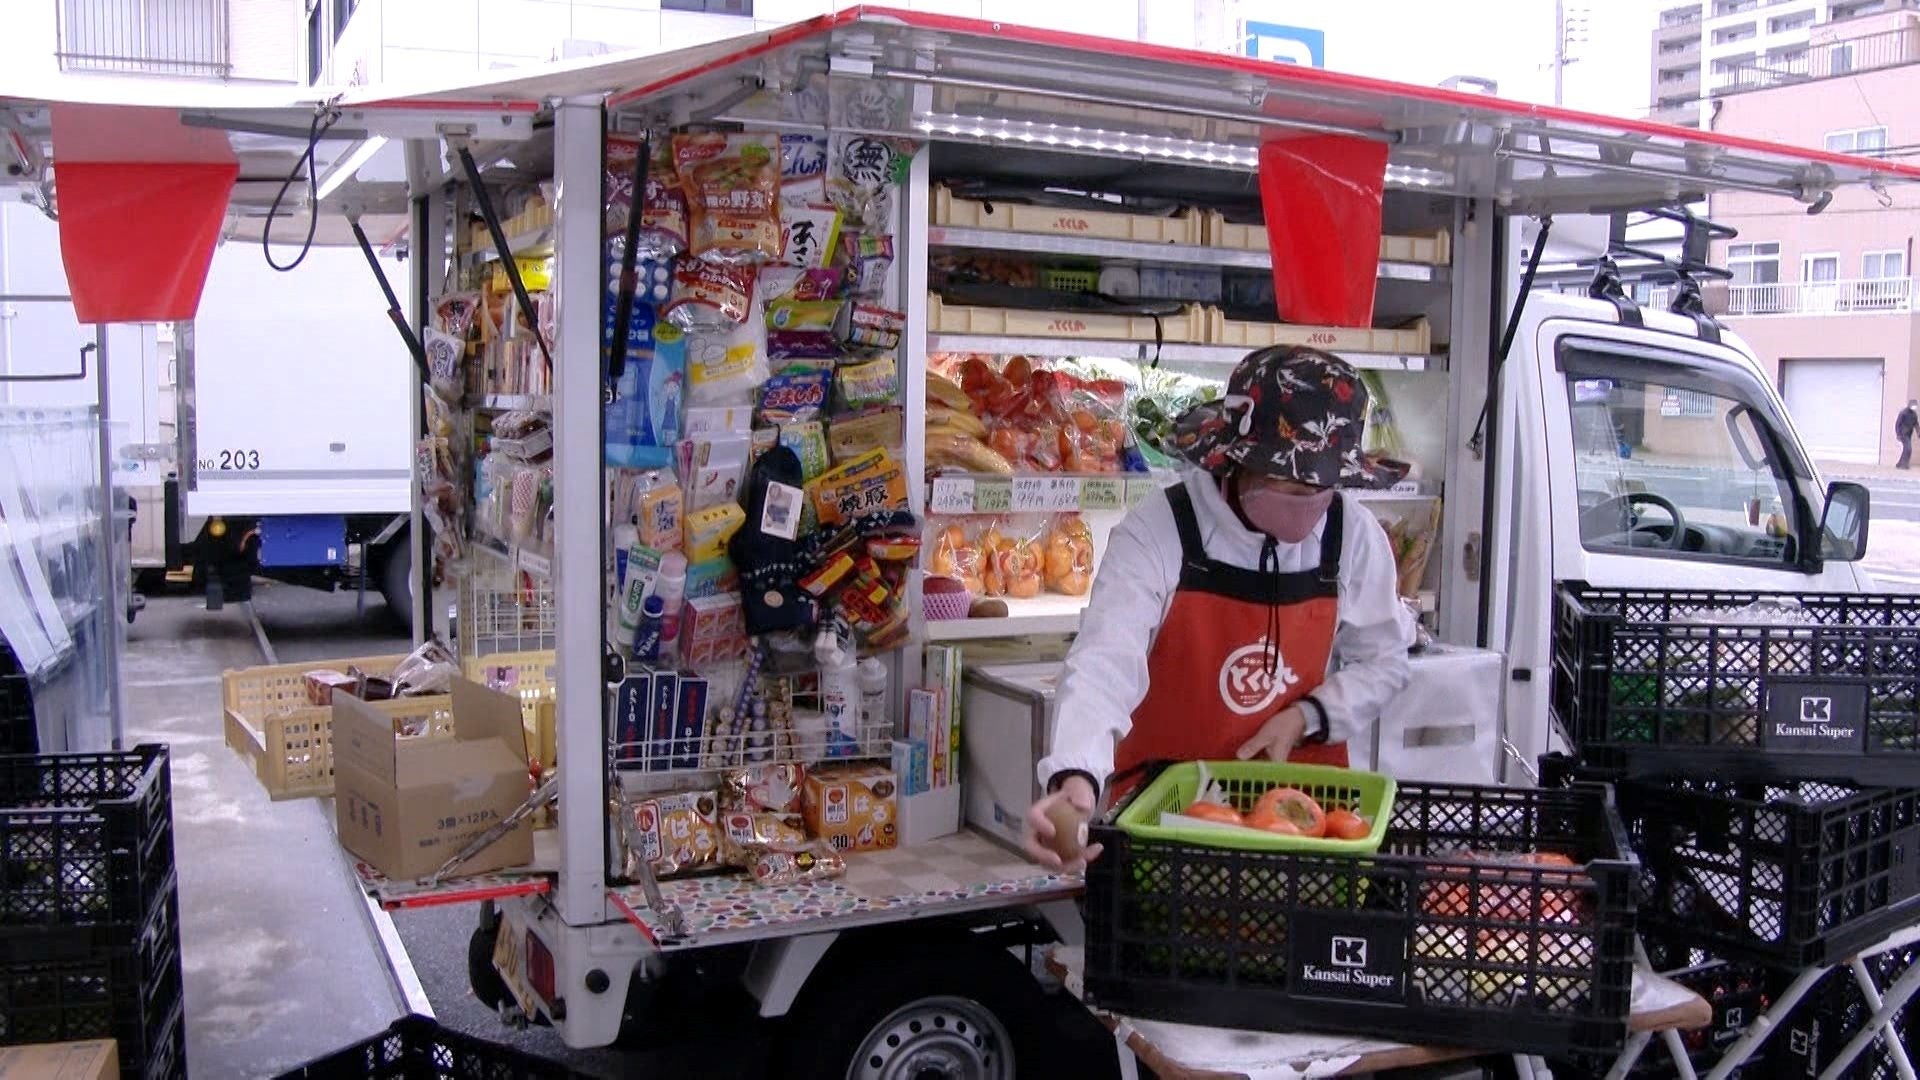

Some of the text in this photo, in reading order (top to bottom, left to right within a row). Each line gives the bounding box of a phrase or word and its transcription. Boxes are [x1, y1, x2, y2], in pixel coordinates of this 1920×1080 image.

[219, 449, 261, 470] 203
[1775, 723, 1855, 738] Kansai Super
[1303, 965, 1394, 988] Kansai Super
